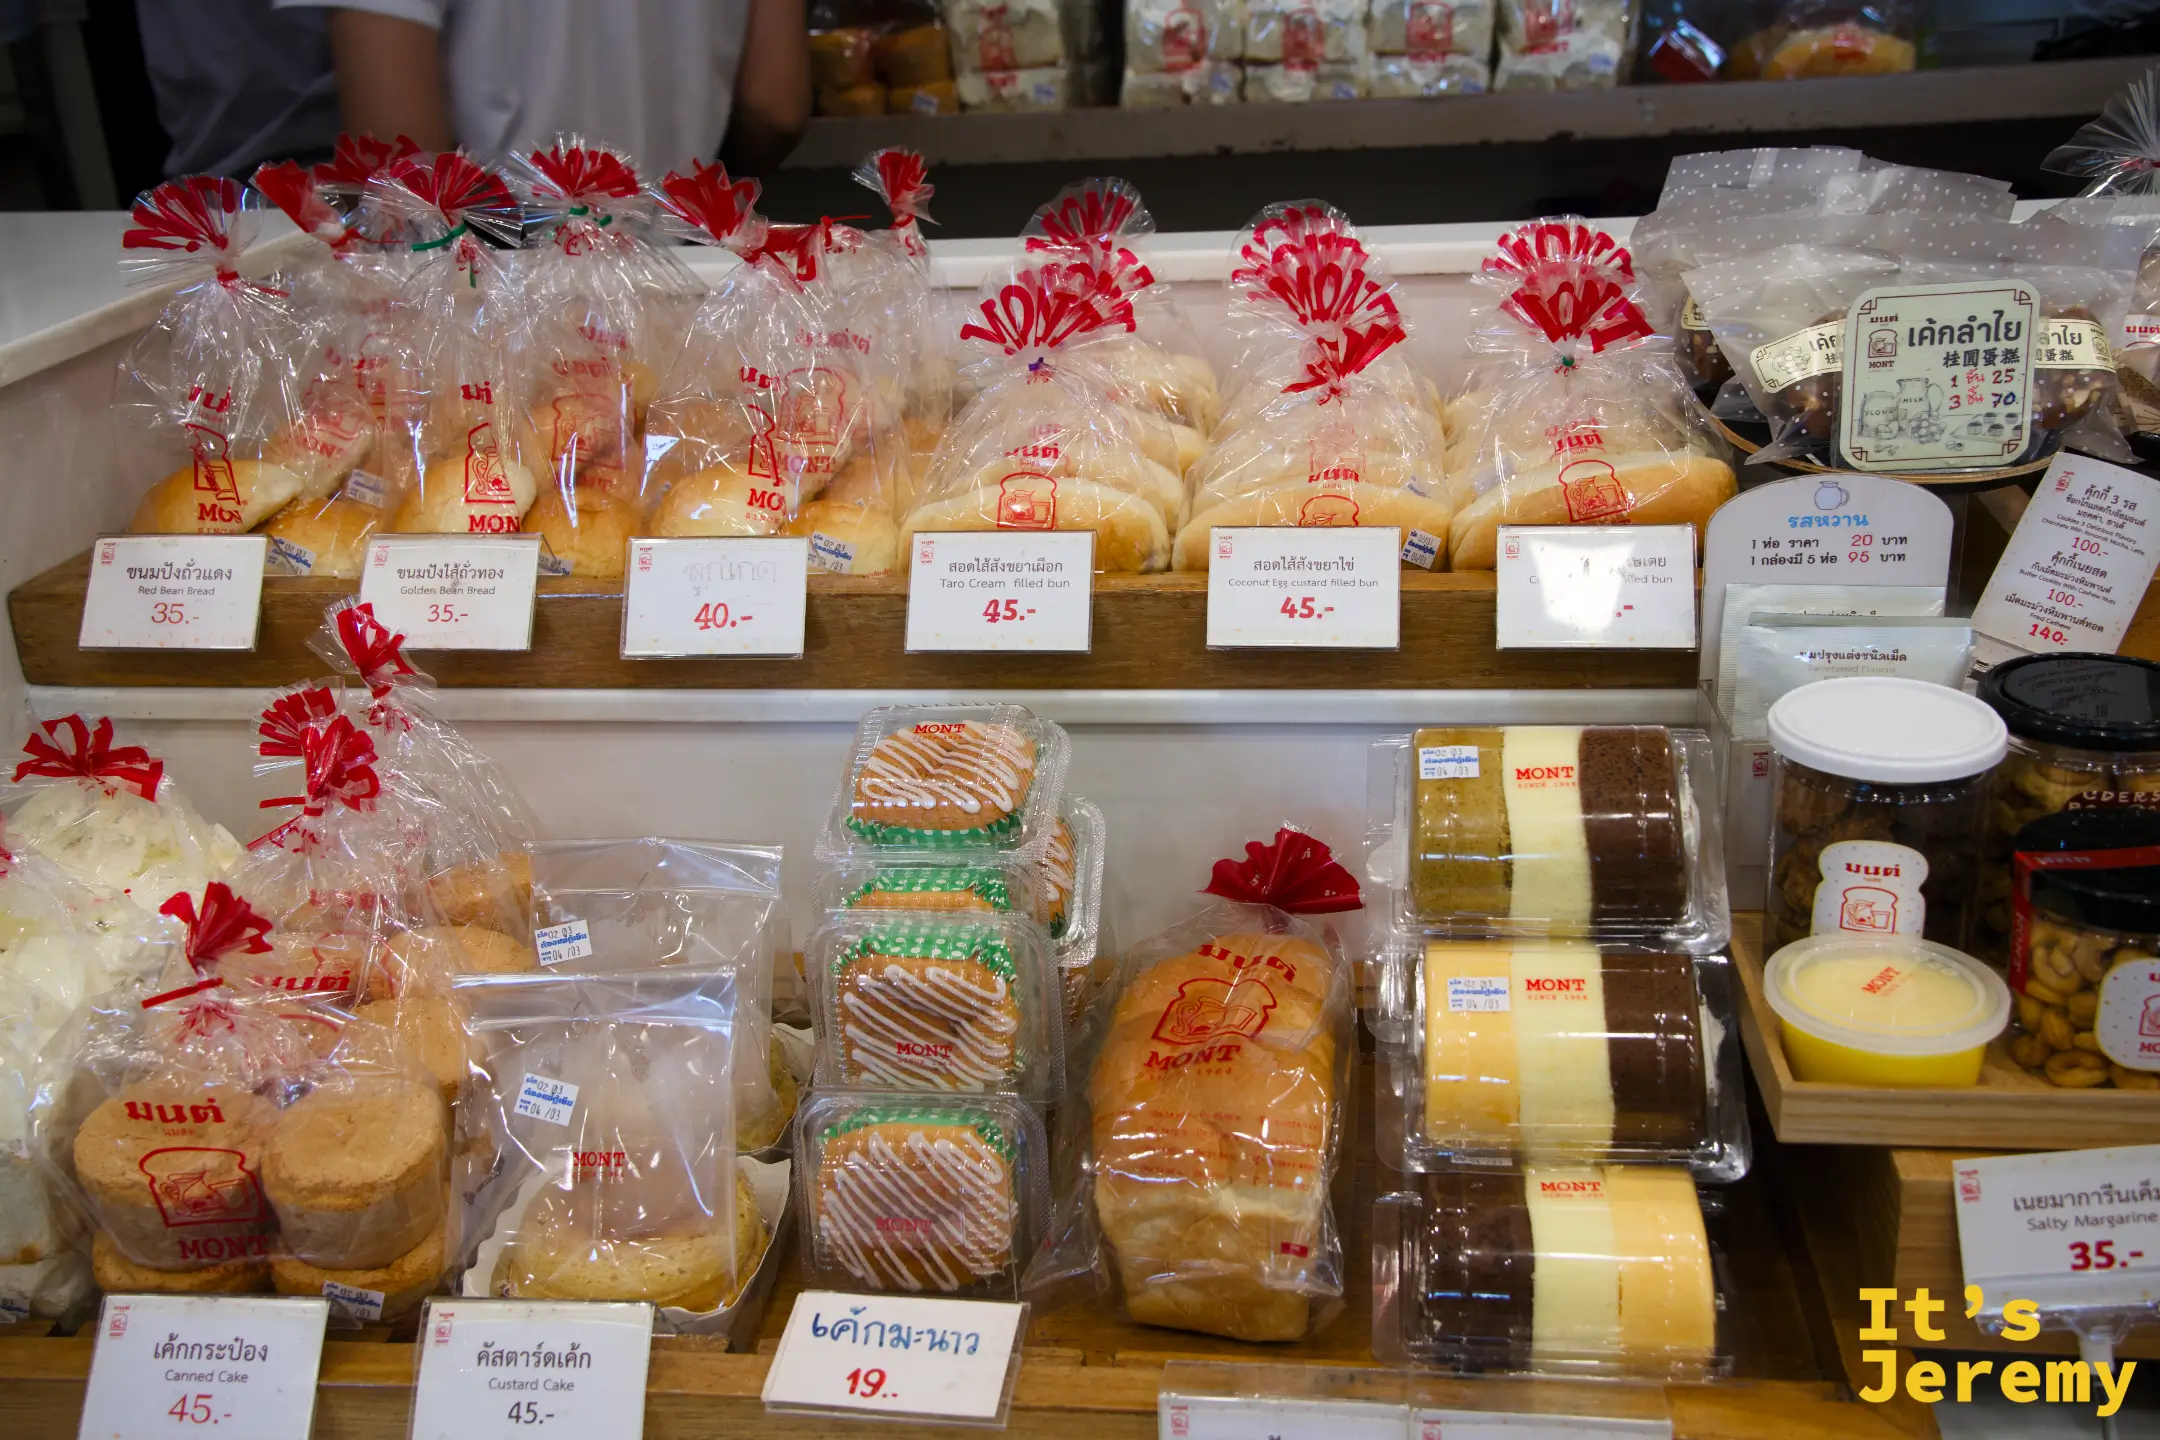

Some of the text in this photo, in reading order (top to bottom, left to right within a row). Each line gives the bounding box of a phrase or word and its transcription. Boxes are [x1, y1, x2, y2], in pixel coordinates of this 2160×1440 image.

[1908, 310, 2021, 347] เค้กลำไย
[1869, 361, 1894, 369] MONT
[1943, 349, 2020, 368] 桂圓蛋糕
[1950, 375, 1958, 387] 1
[1992, 369, 2015, 384] 25
[1948, 395, 1961, 410] 3
[2110, 494, 2119, 505] 3
[2123, 500, 2137, 511] รส
[1787, 513, 1869, 528] รสหวาน
[2056, 514, 2079, 524] Cookies
[1752, 534, 1908, 549] 1 ห่อ ราคา 20 บาท
[2071, 537, 2108, 556] 100.-
[949, 556, 1063, 573] สอดไส้สังขยาเผือก
[1253, 555, 1355, 571] สอดไส้สังขยาไข่
[1751, 551, 1906, 566] 1 กล่องมี 5 ห่อ 95 บาท
[126, 558, 232, 581] ขนมปังถั่วแดง
[397, 560, 504, 580] ขนมปังไส้ถั่วทอง
[940, 578, 1070, 588] Taro Cream filled bun
[1228, 578, 1379, 589] Coconut Egg custard filled bun
[1652, 574, 1673, 583] bun
[138, 586, 215, 596] Red Bean Bread
[400, 586, 496, 595] Golden Bean Bread
[2046, 588, 2083, 609] 100.-
[151, 602, 200, 624] 35.-
[427, 604, 469, 623] 35.-
[982, 598, 1037, 623] 45.-
[1280, 596, 1335, 619] 45.-
[693, 602, 754, 631] 40.-
[2029, 612, 2045, 623] Fried
[914, 723, 966, 734] MONT
[1516, 766, 1575, 780] MONT
[1845, 863, 1901, 877] มนต์
[1525, 978, 1586, 991] MONT
[1861, 966, 1901, 994] MONT
[896, 1042, 952, 1058] MONT
[1144, 1045, 1241, 1070] MONT
[537, 1081, 549, 1093] 02
[124, 1097, 226, 1124] มนต์
[573, 1152, 625, 1167] MONT
[1540, 1181, 1602, 1192] MONT
[875, 1216, 932, 1234] MONT
[2027, 1211, 2158, 1232] Salty Margarine
[178, 1235, 269, 1260] MONT
[2068, 1240, 2144, 1271] 35.-
[811, 1306, 980, 1355] เค้กมะนาว
[153, 1332, 268, 1362] เค้กกระป๋อง
[477, 1341, 592, 1369] คัสตาร์ดเค้ก
[165, 1370, 248, 1383] Canned Cake
[488, 1377, 575, 1392] Custard Cake
[168, 1393, 232, 1425] 45.-
[508, 1401, 555, 1425] 45.-
